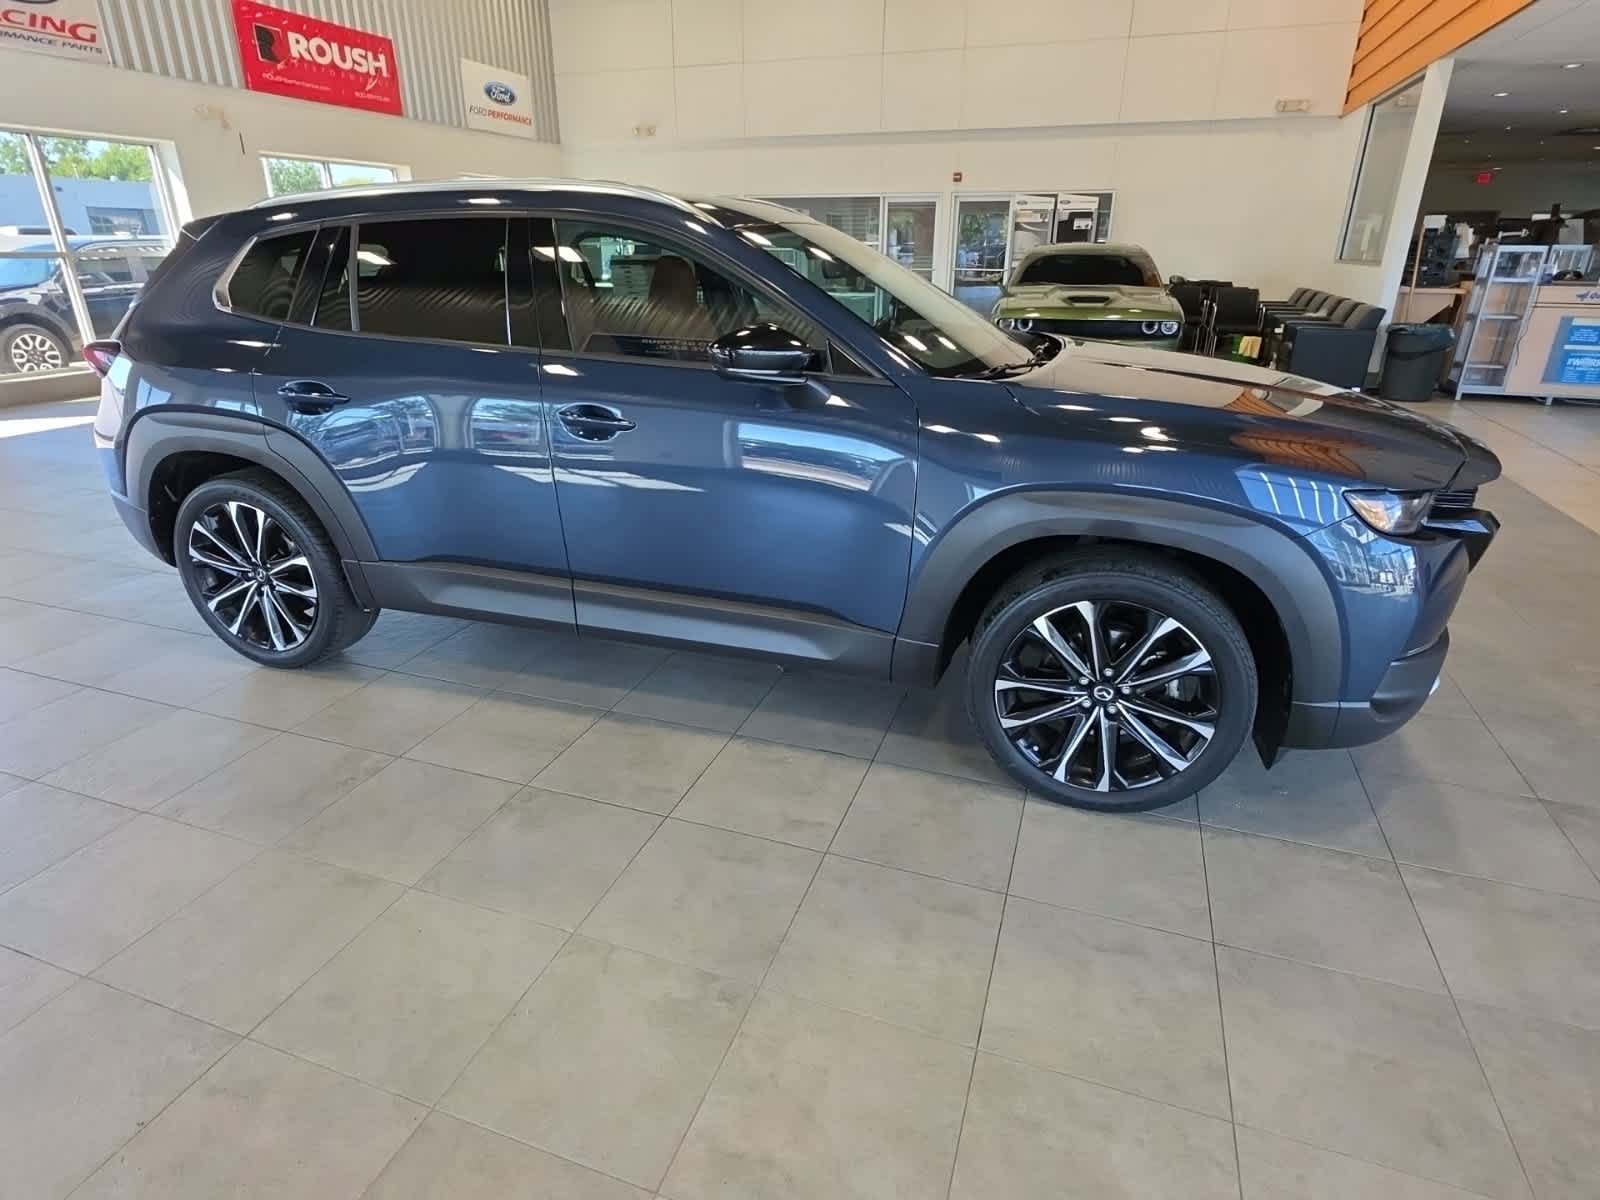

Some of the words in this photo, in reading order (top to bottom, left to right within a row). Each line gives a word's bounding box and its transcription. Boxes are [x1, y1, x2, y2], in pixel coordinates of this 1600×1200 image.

[0, 9, 97, 43] CING
[287, 31, 388, 77] ROUSH
[490, 86, 511, 102] Ford
[487, 109, 532, 126] PERFORMANCE
